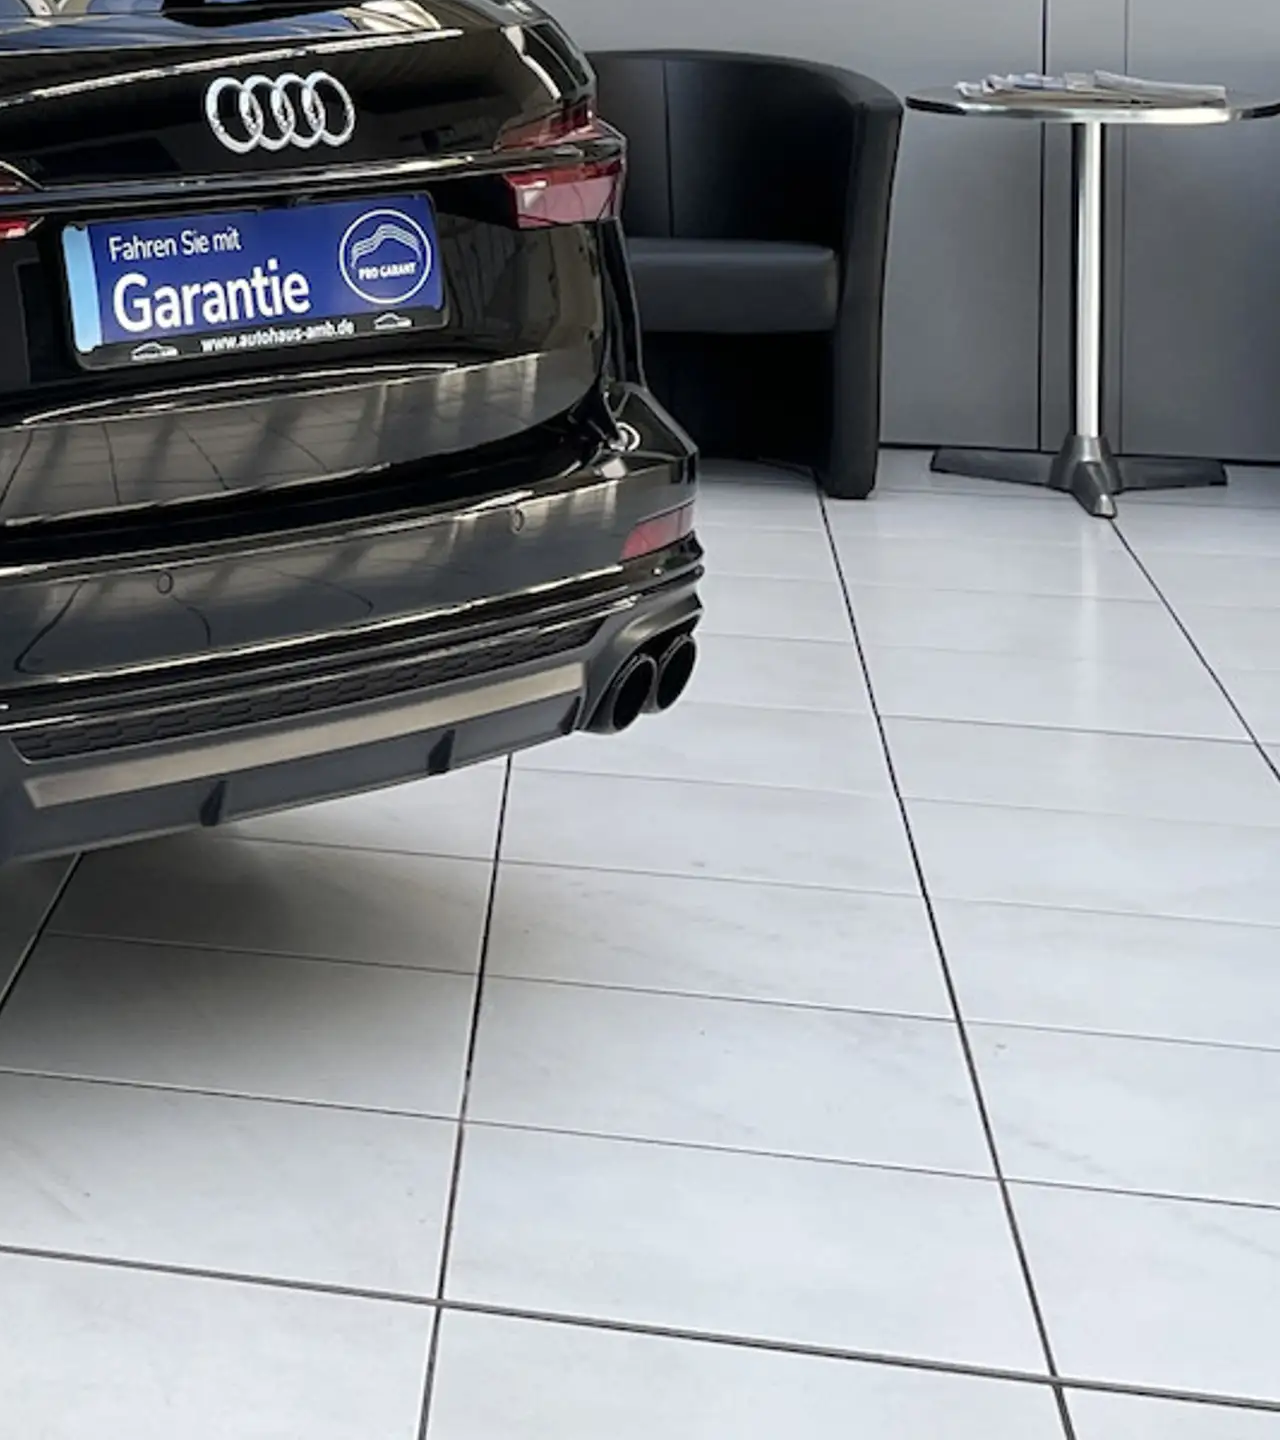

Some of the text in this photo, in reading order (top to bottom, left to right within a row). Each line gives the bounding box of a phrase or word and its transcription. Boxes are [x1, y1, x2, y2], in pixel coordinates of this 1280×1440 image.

[108, 224, 243, 262] Fahren Sie mit
[358, 262, 417, 281] PRO GARANT
[113, 258, 312, 333] Garantie
[200, 318, 355, 353] www.autohaus-amb.de
